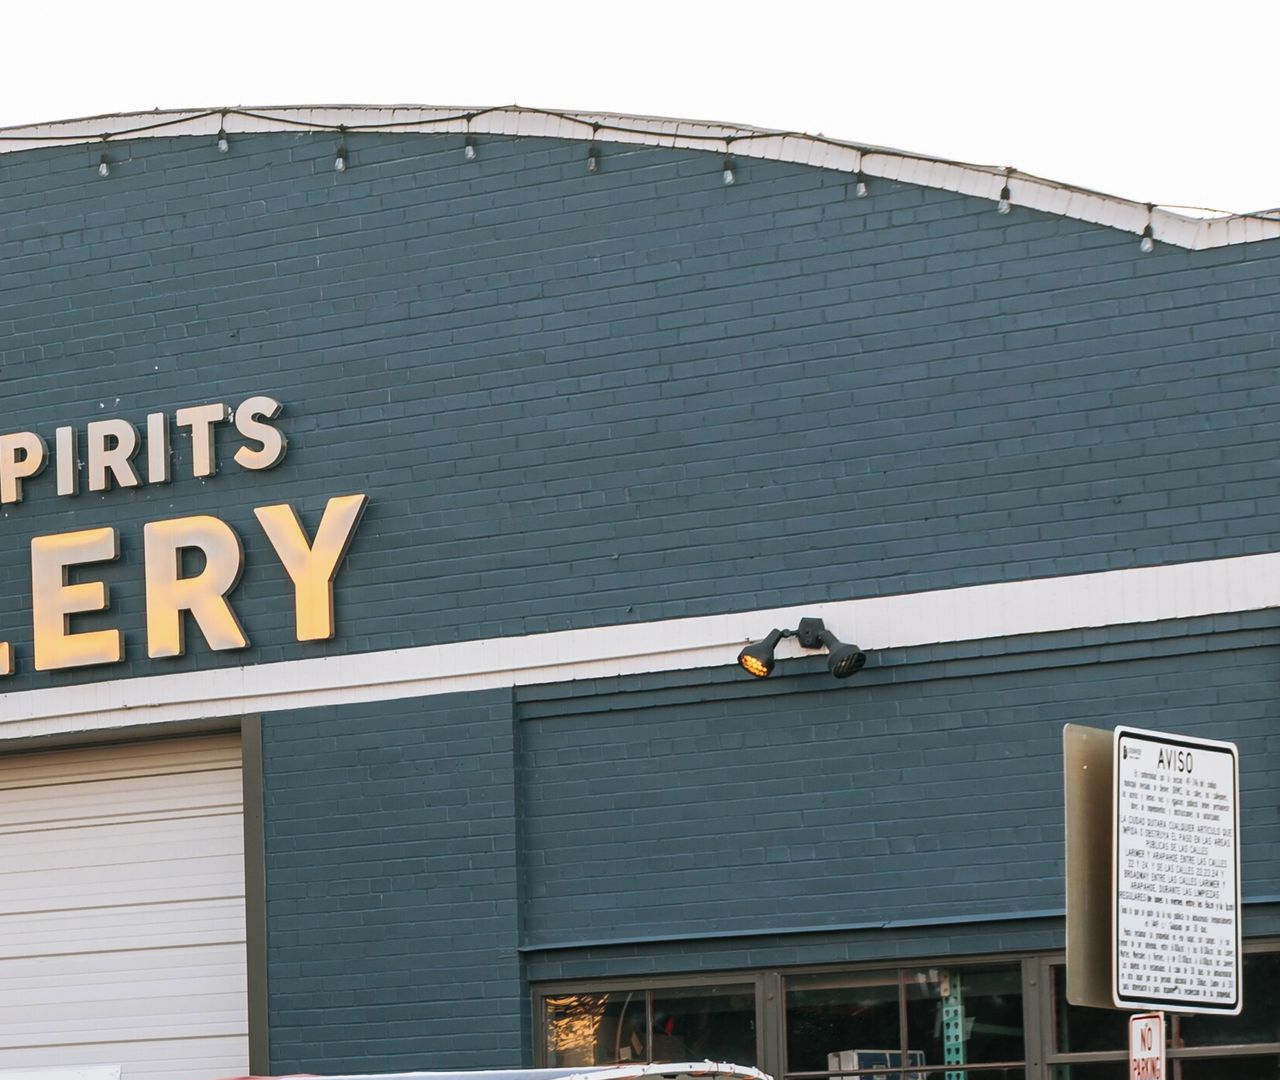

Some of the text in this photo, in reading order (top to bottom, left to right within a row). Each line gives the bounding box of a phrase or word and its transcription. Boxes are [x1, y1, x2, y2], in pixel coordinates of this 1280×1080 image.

[1157, 748, 1193, 773] AVISO
[1140, 1027, 1153, 1051] NO
[1133, 1057, 1160, 1080] PARKING
